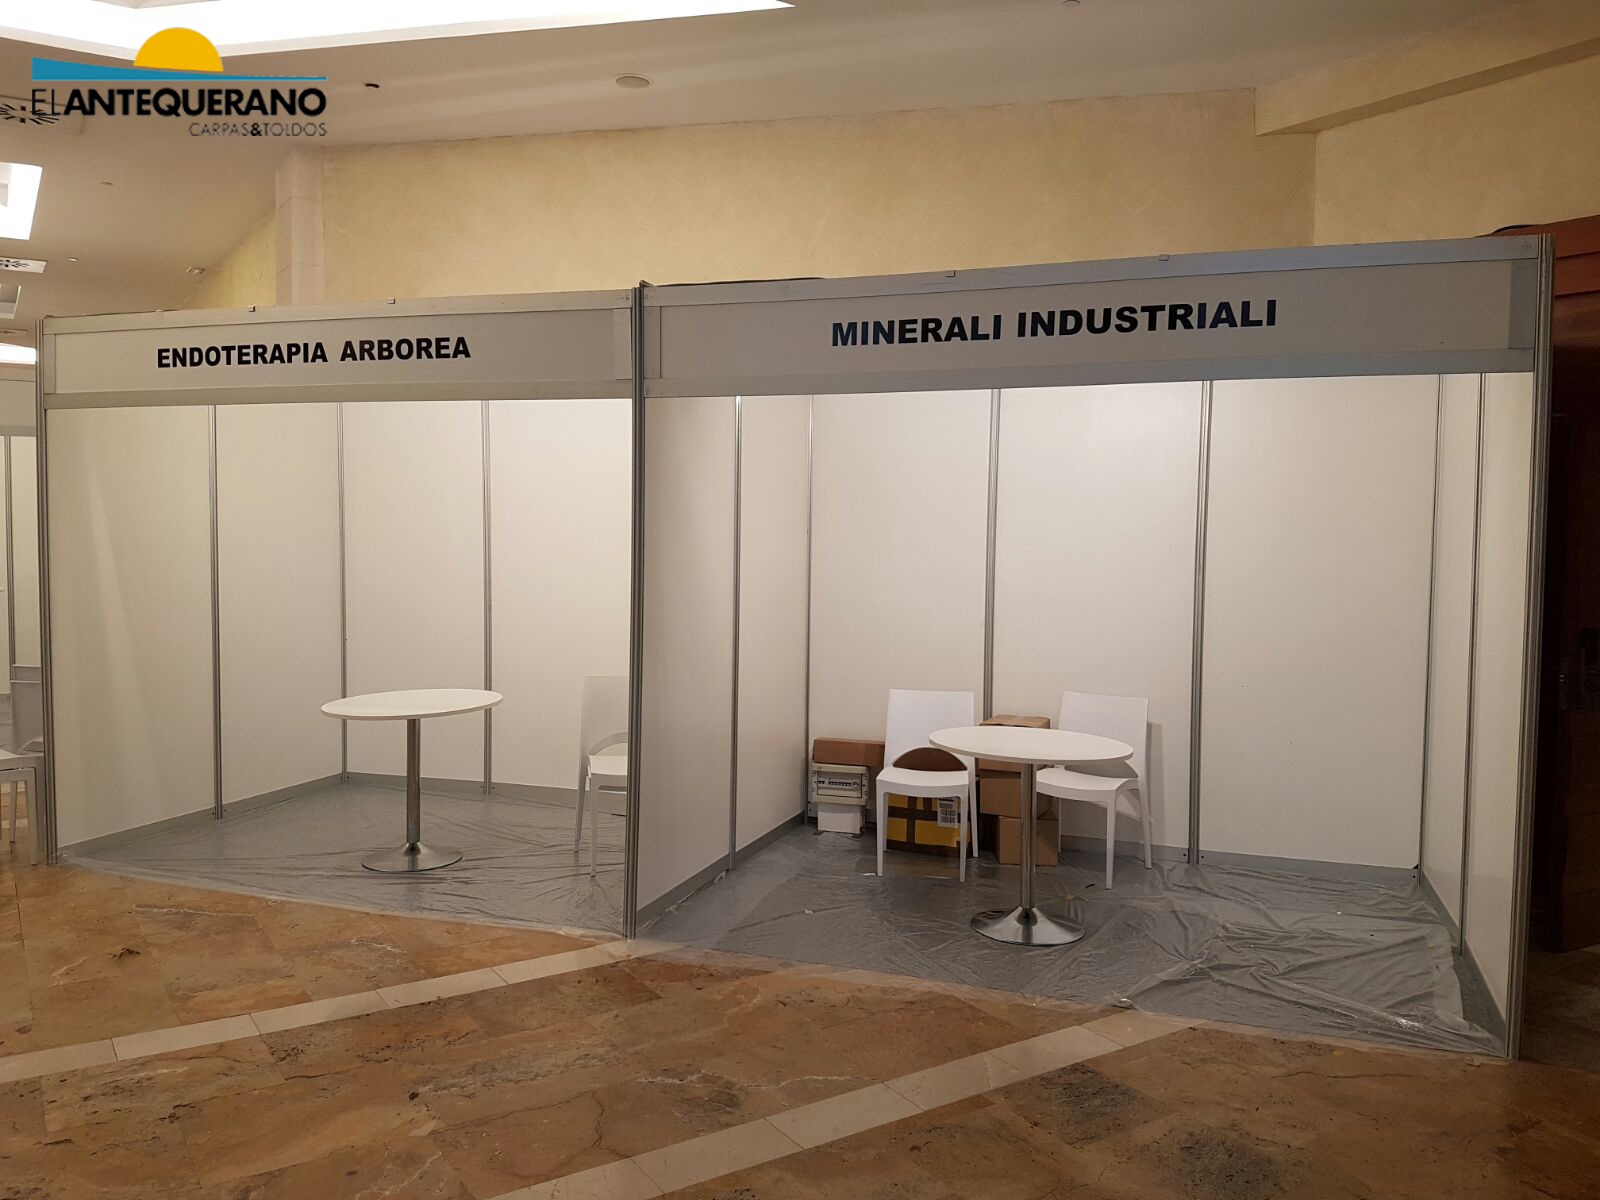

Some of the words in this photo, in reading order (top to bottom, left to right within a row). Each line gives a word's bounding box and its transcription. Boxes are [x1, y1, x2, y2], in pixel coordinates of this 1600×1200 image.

[831, 314, 1002, 347] MINERALI
[1016, 299, 1277, 338] INDUSTRIALI
[157, 341, 329, 369] ENDOTERAPIA
[339, 336, 472, 363] ARBOREA
